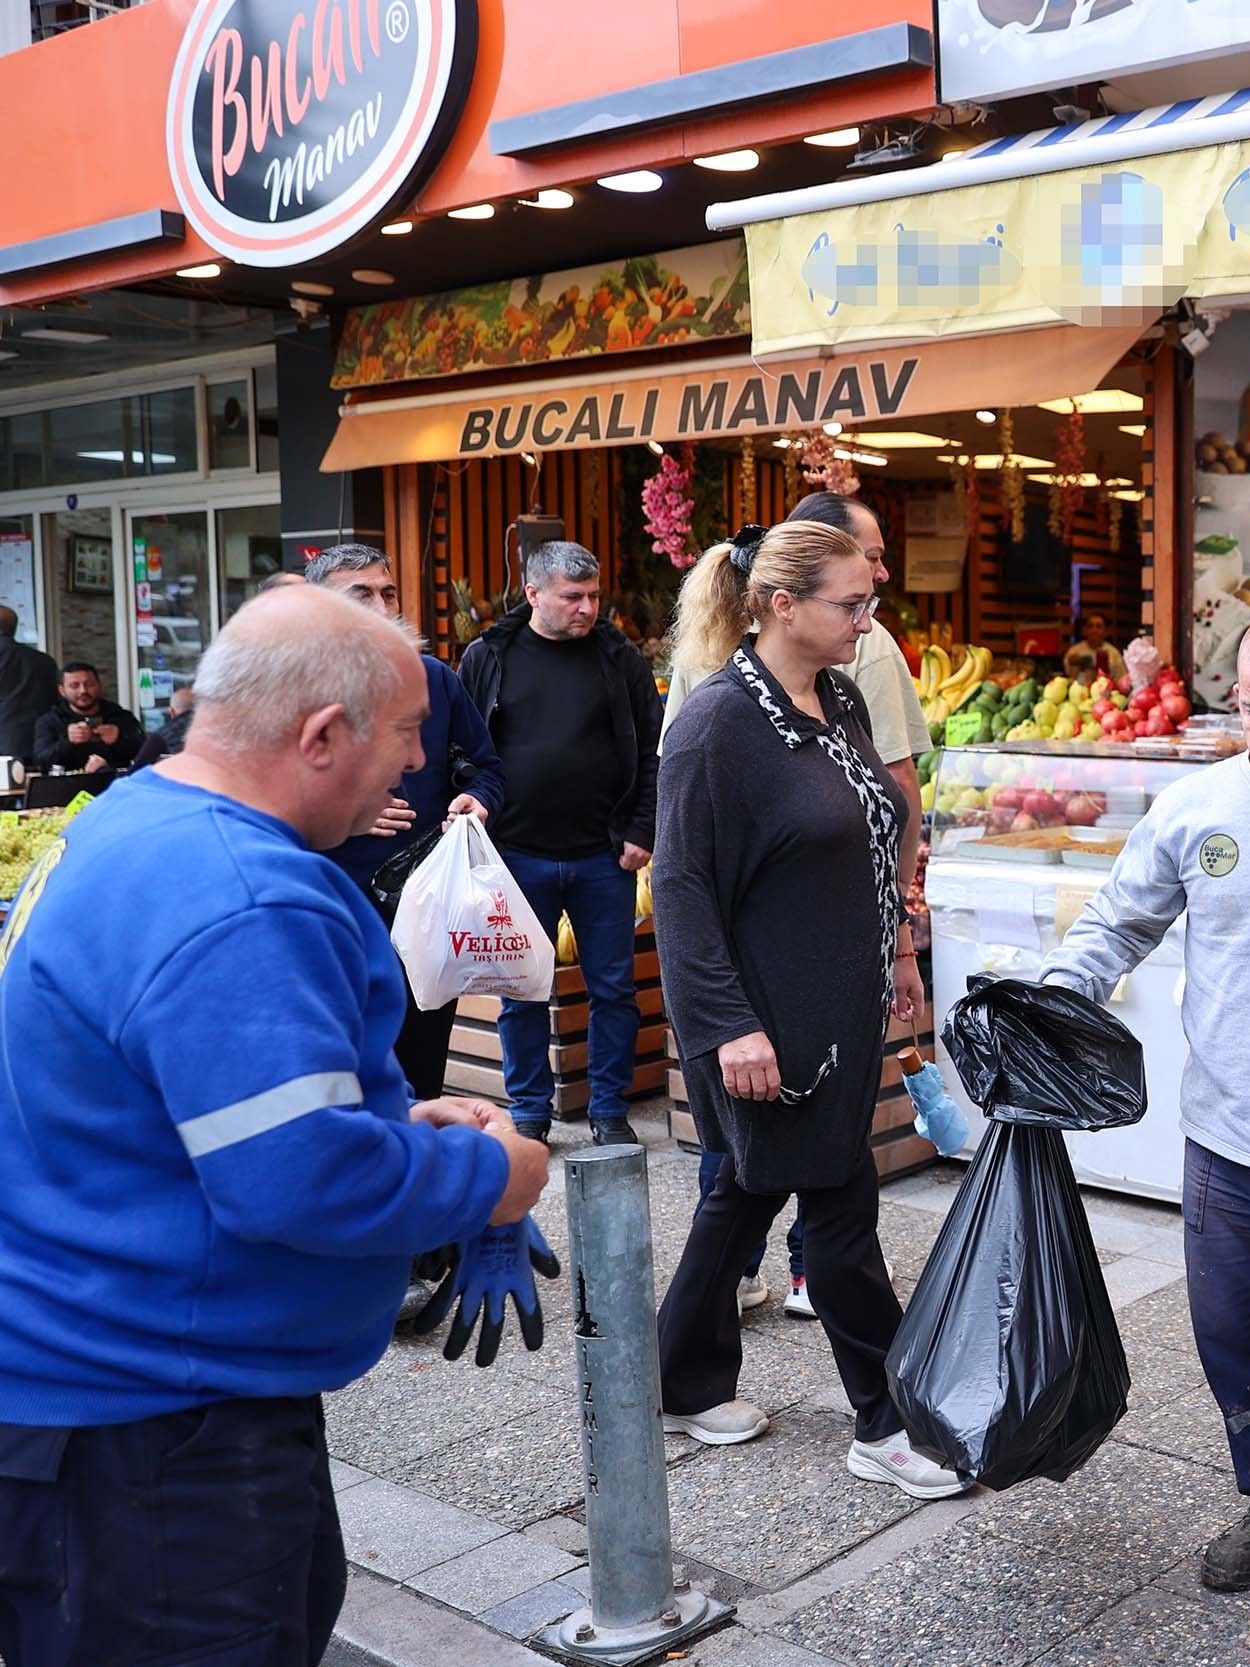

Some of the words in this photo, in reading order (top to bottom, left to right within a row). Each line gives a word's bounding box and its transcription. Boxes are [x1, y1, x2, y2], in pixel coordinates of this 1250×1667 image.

[263, 92, 382, 221] Manav
[459, 389, 660, 453] BUCALI
[678, 359, 919, 433] MANAV
